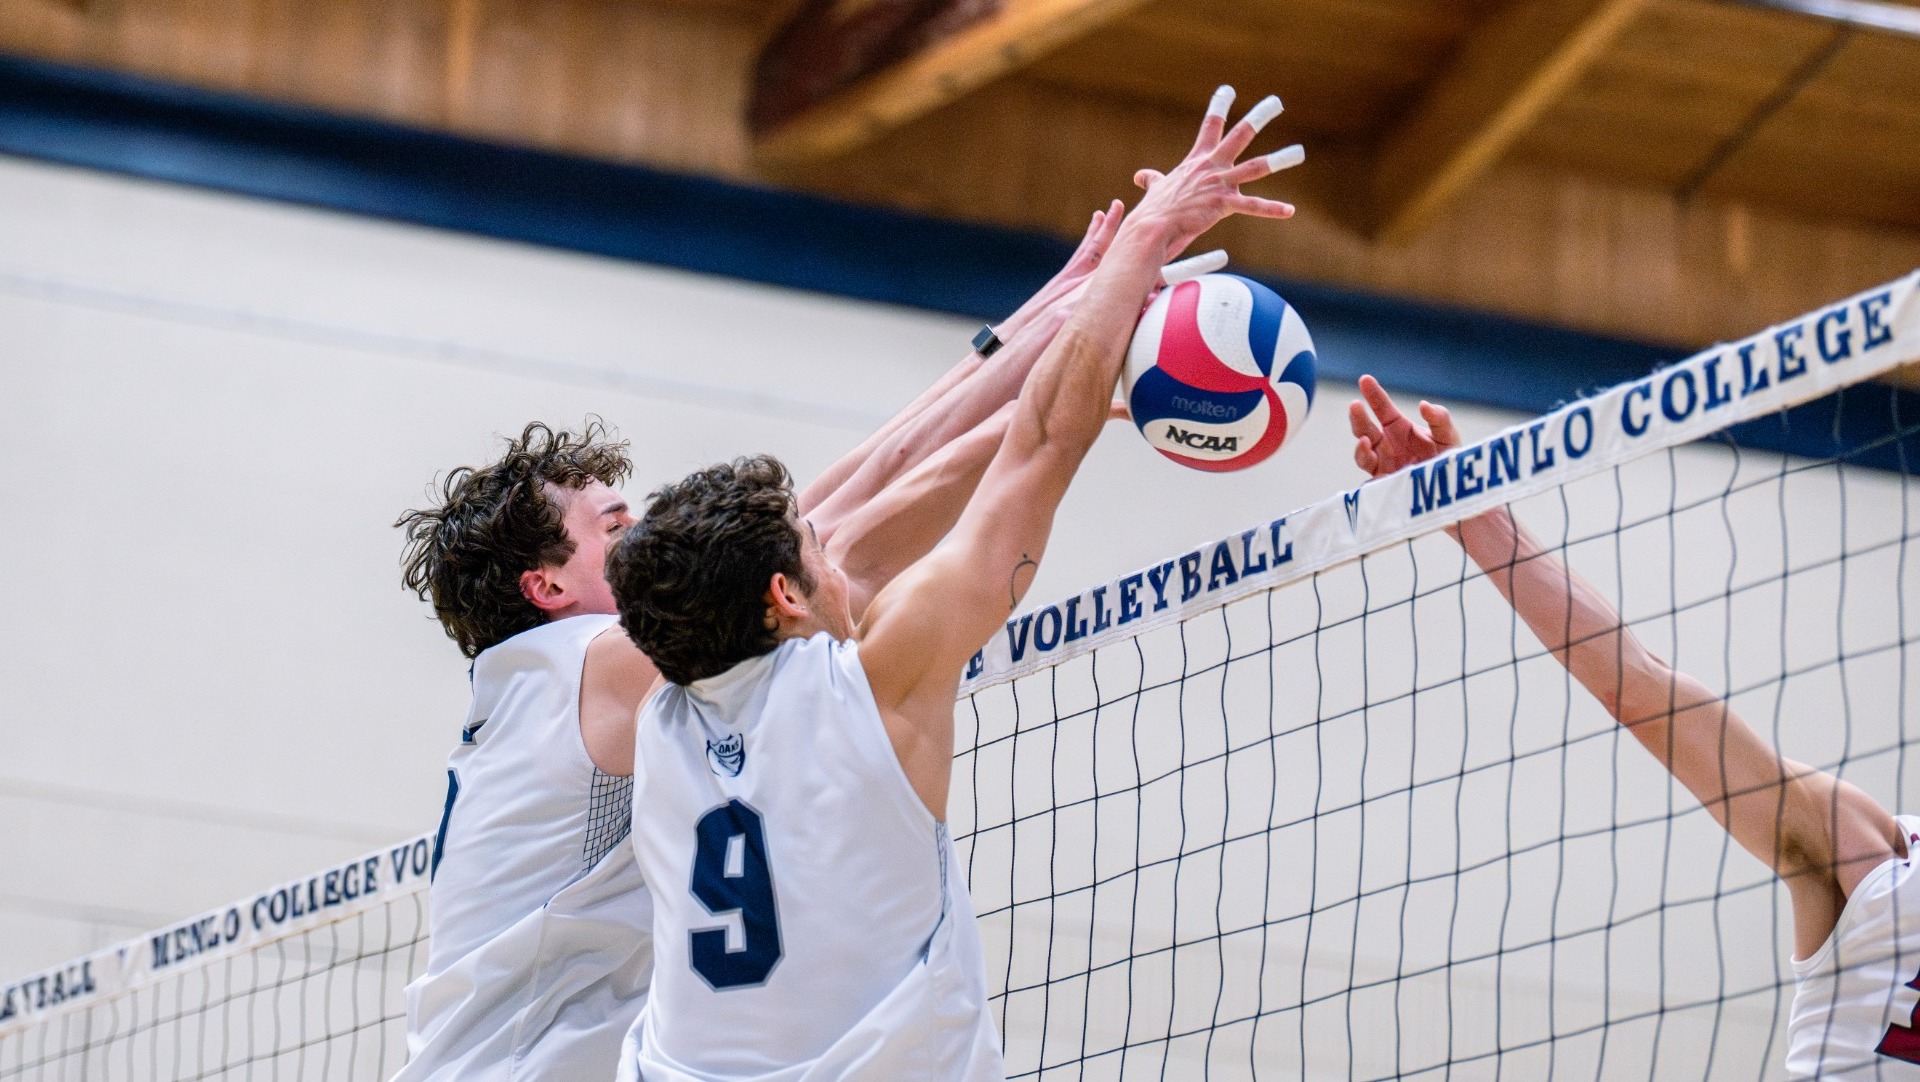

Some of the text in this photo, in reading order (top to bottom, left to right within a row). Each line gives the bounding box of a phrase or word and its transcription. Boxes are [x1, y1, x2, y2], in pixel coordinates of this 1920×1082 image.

[1165, 425, 1238, 452] NCAA
[1171, 395, 1239, 419] molten
[1409, 291, 1894, 518] MENLO COLLEGE
[1006, 518, 1294, 663] VOLLEYBALL
[152, 907, 241, 970] MENLO
[688, 796, 786, 993] 9
